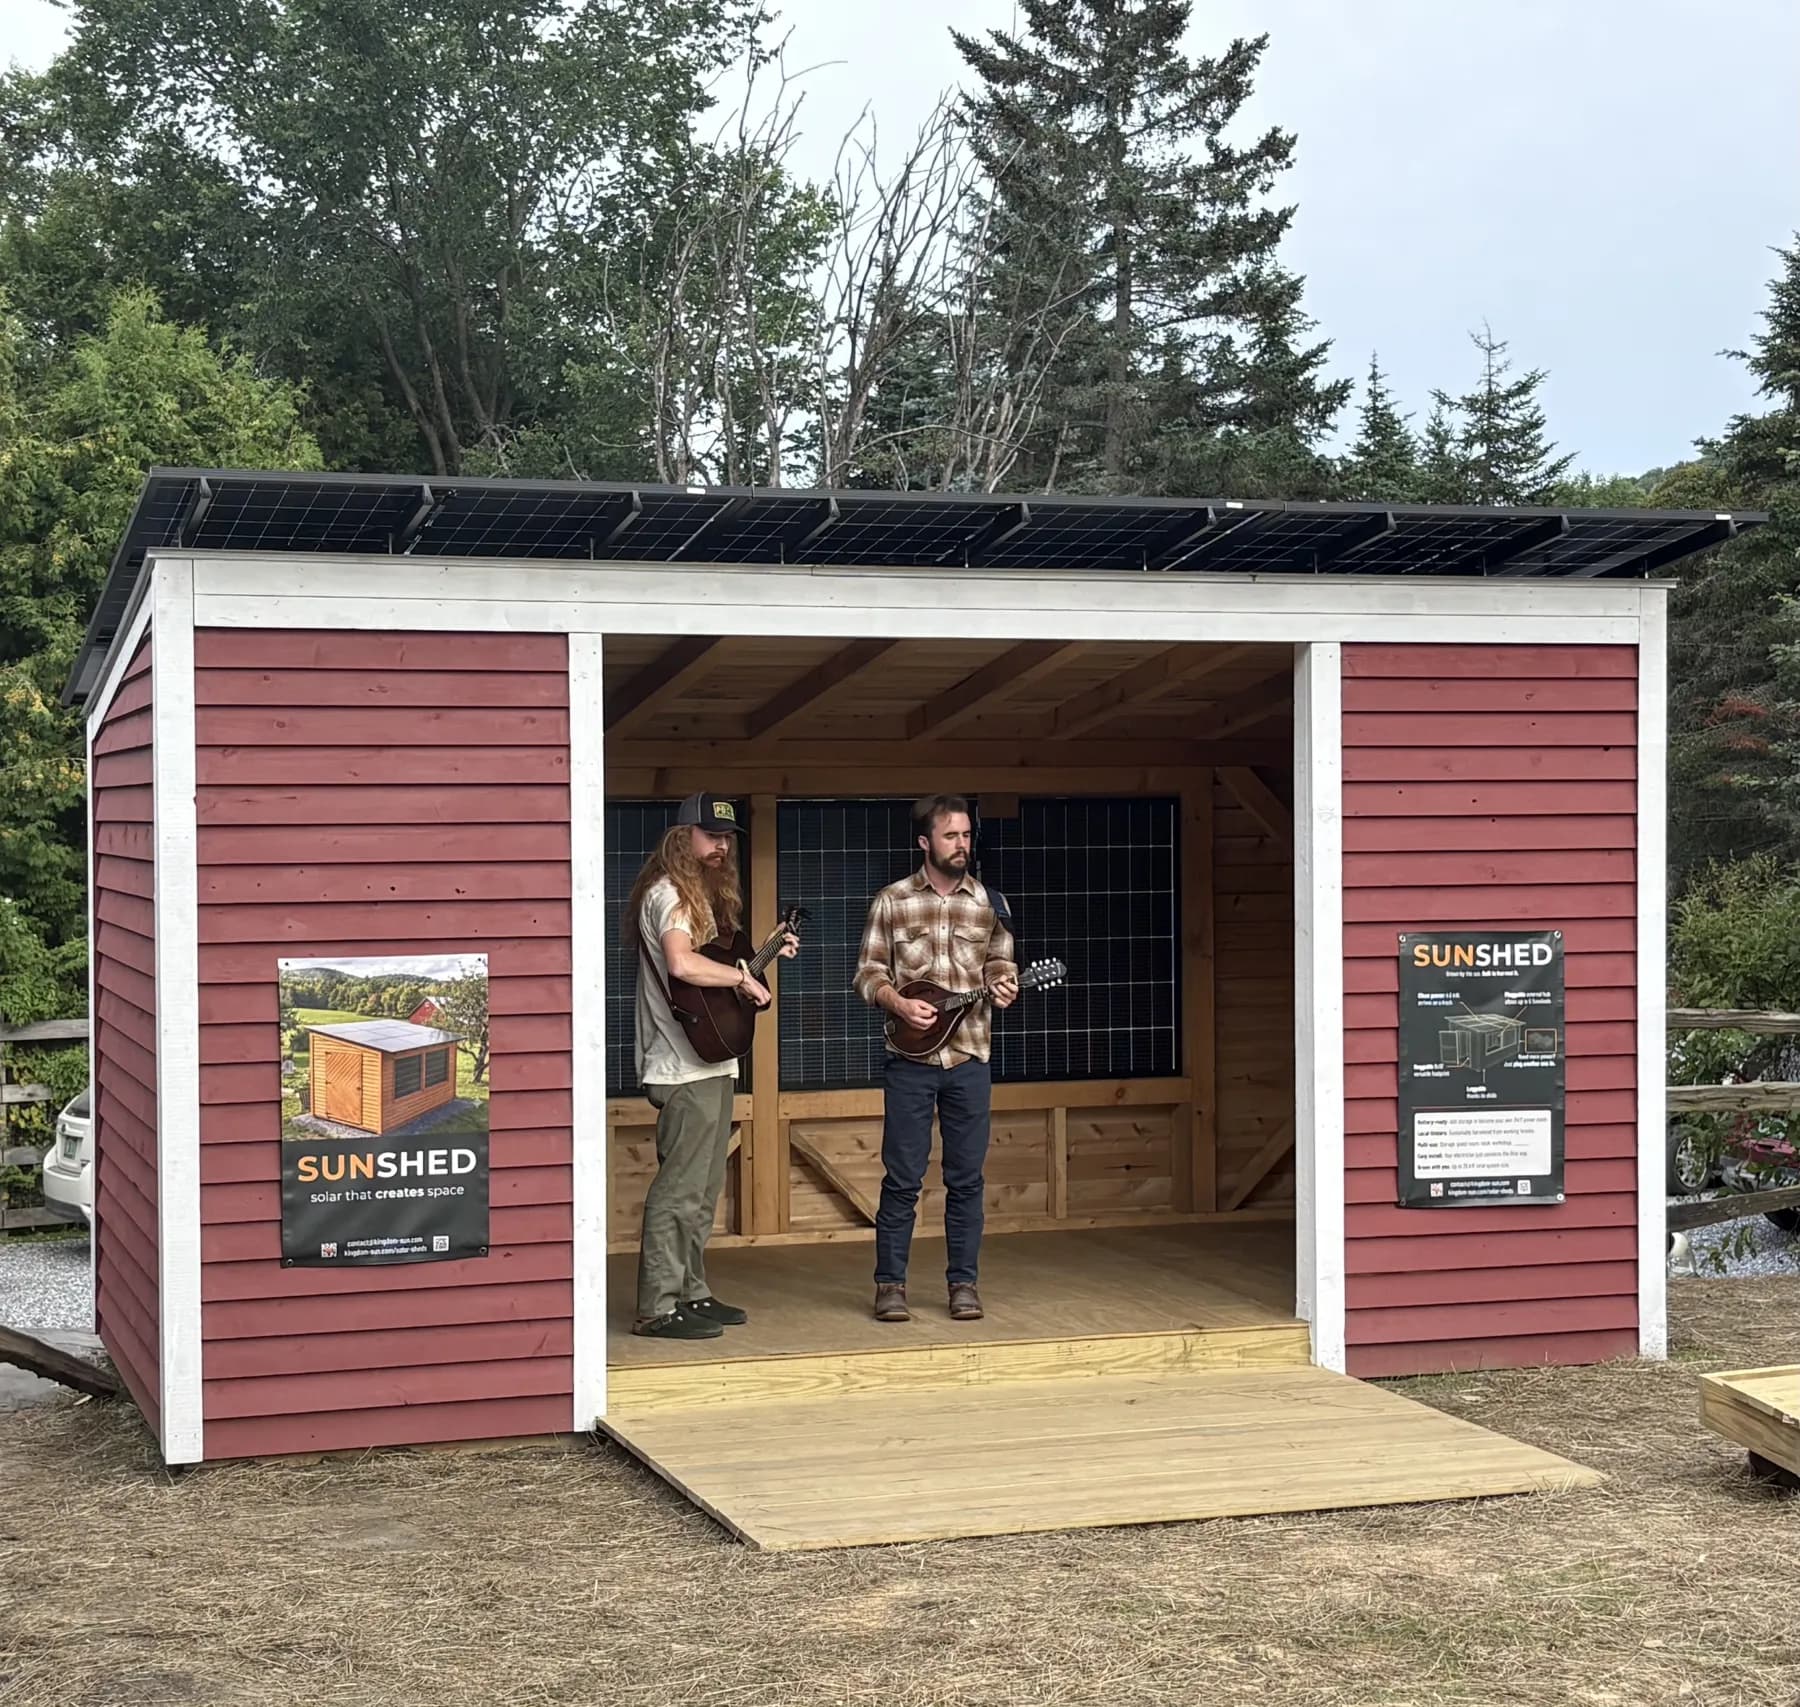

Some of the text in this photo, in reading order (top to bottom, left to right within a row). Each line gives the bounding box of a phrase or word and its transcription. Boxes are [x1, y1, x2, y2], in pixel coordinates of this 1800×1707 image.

[1413, 943, 1552, 967] SUNSHED
[298, 1148, 477, 1182] SUNSHED
[310, 1185, 465, 1203] solar that creates space
